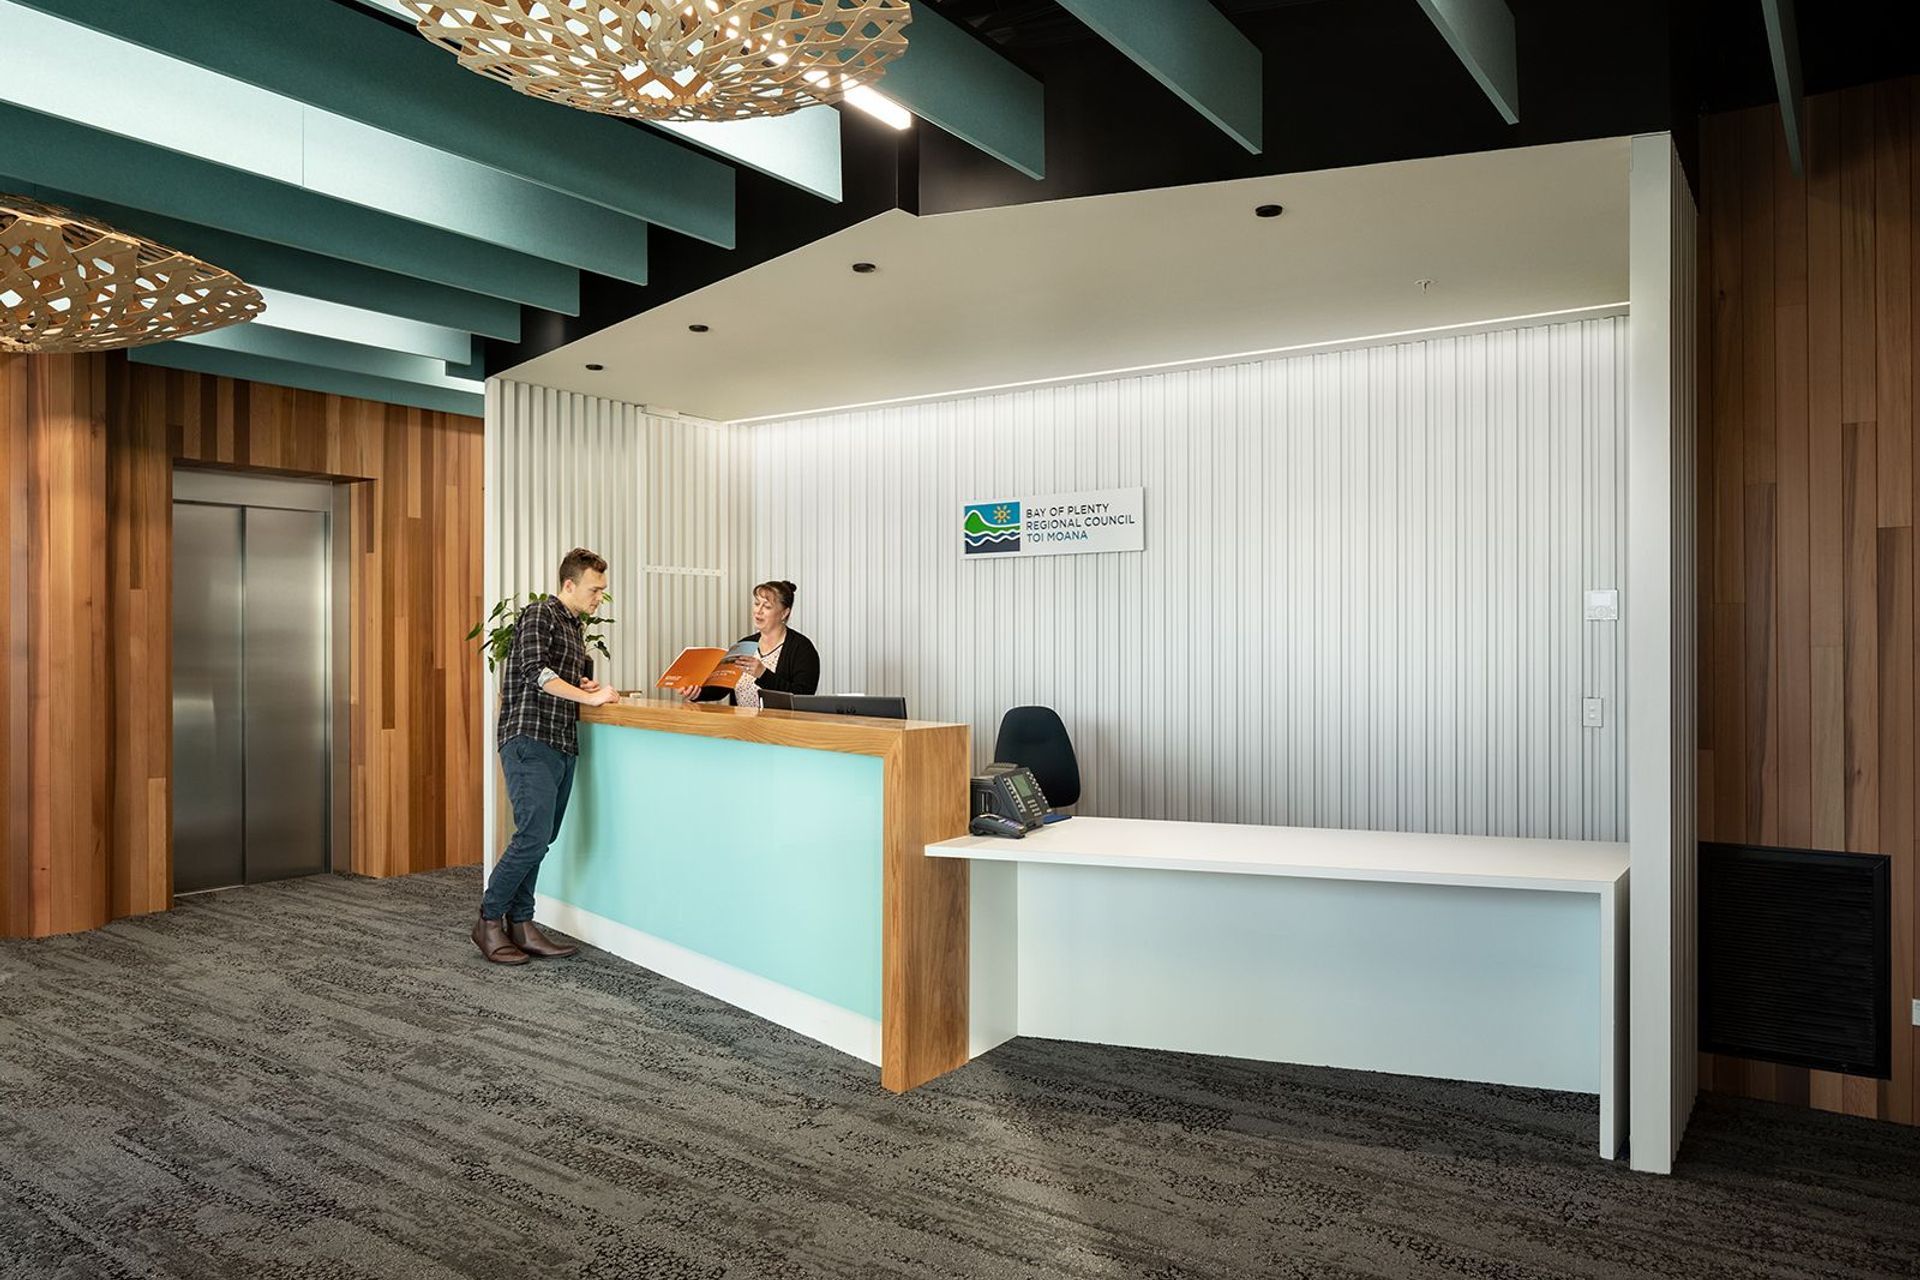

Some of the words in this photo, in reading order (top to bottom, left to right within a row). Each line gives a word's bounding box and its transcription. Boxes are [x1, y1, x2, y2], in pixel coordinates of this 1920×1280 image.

[1026, 508, 1047, 518] BAY
[1049, 506, 1064, 517] OF
[1068, 503, 1110, 515] PLENTY
[1026, 518, 1082, 530] REGIONAL
[1084, 515, 1135, 527] COUNCIL
[1027, 533, 1044, 543] TOI
[1047, 530, 1088, 541] MOANA
